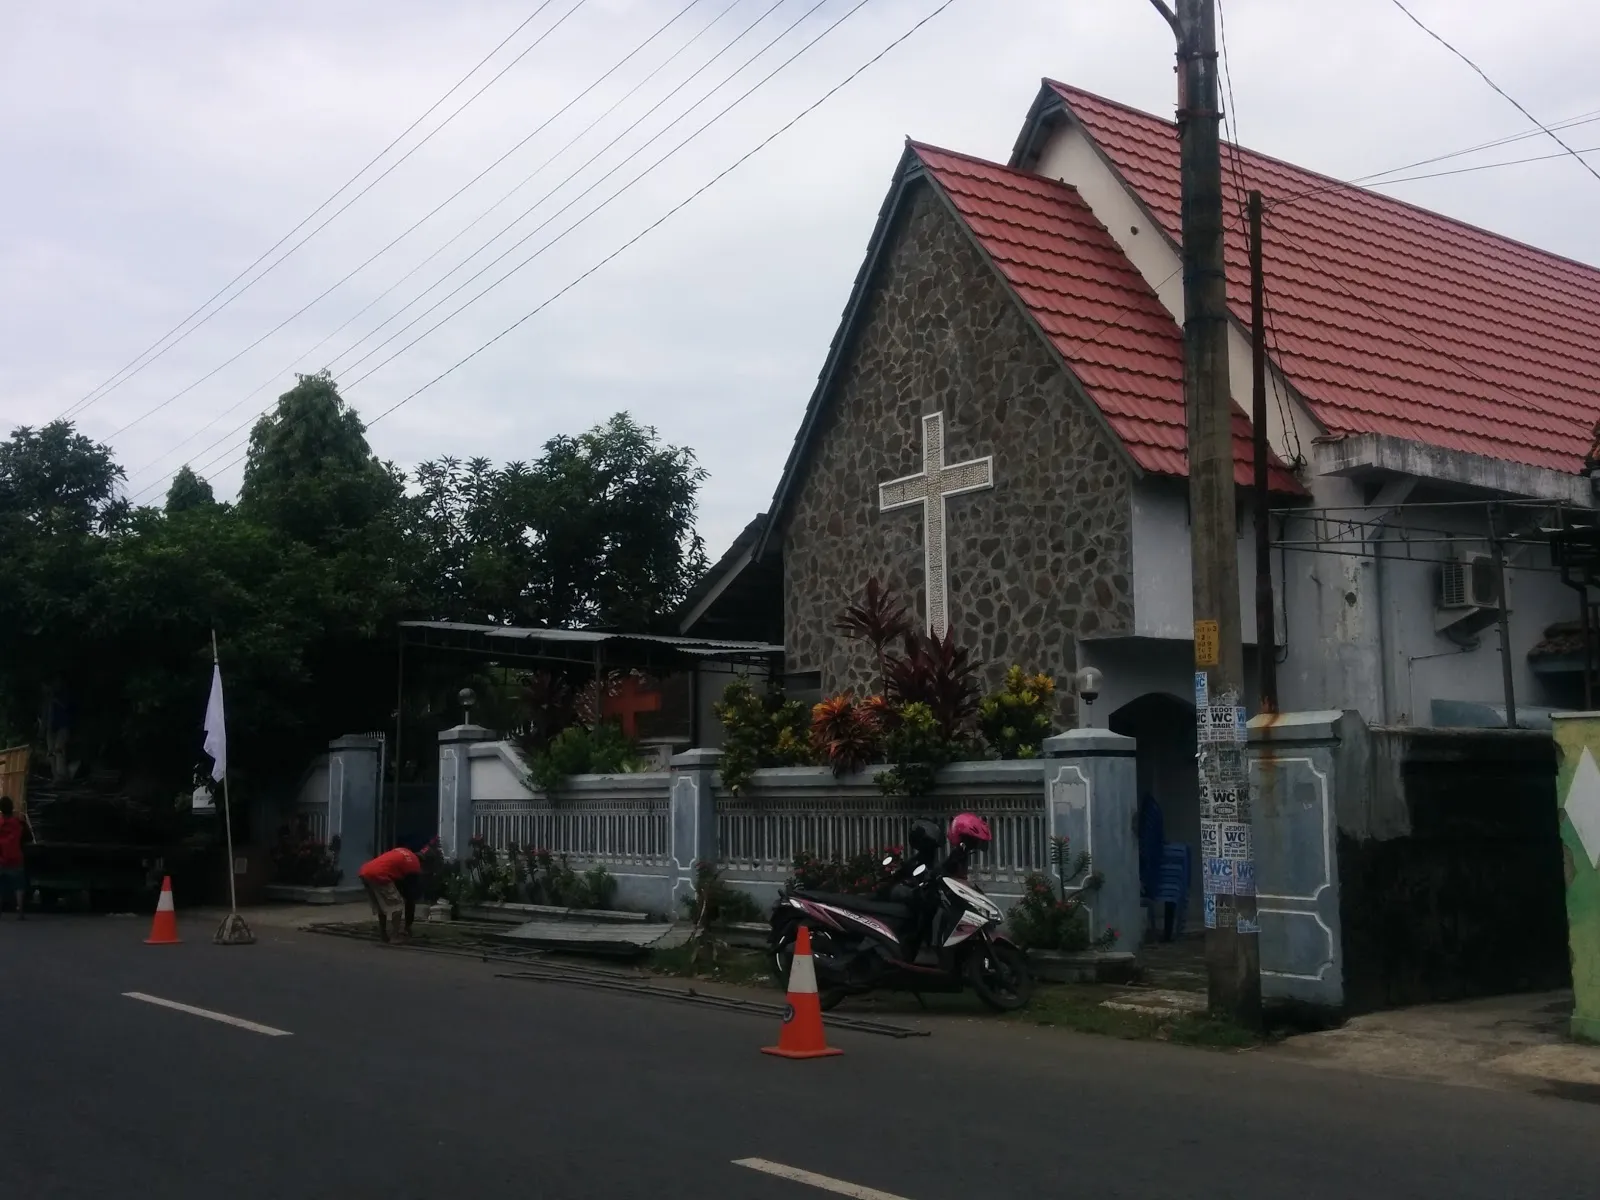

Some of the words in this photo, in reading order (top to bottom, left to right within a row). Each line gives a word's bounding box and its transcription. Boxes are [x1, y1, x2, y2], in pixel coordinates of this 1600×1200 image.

[1211, 713, 1232, 722] WC
[1213, 792, 1235, 802] WC
[1225, 832, 1245, 842] WC
[1210, 864, 1232, 876] WC
